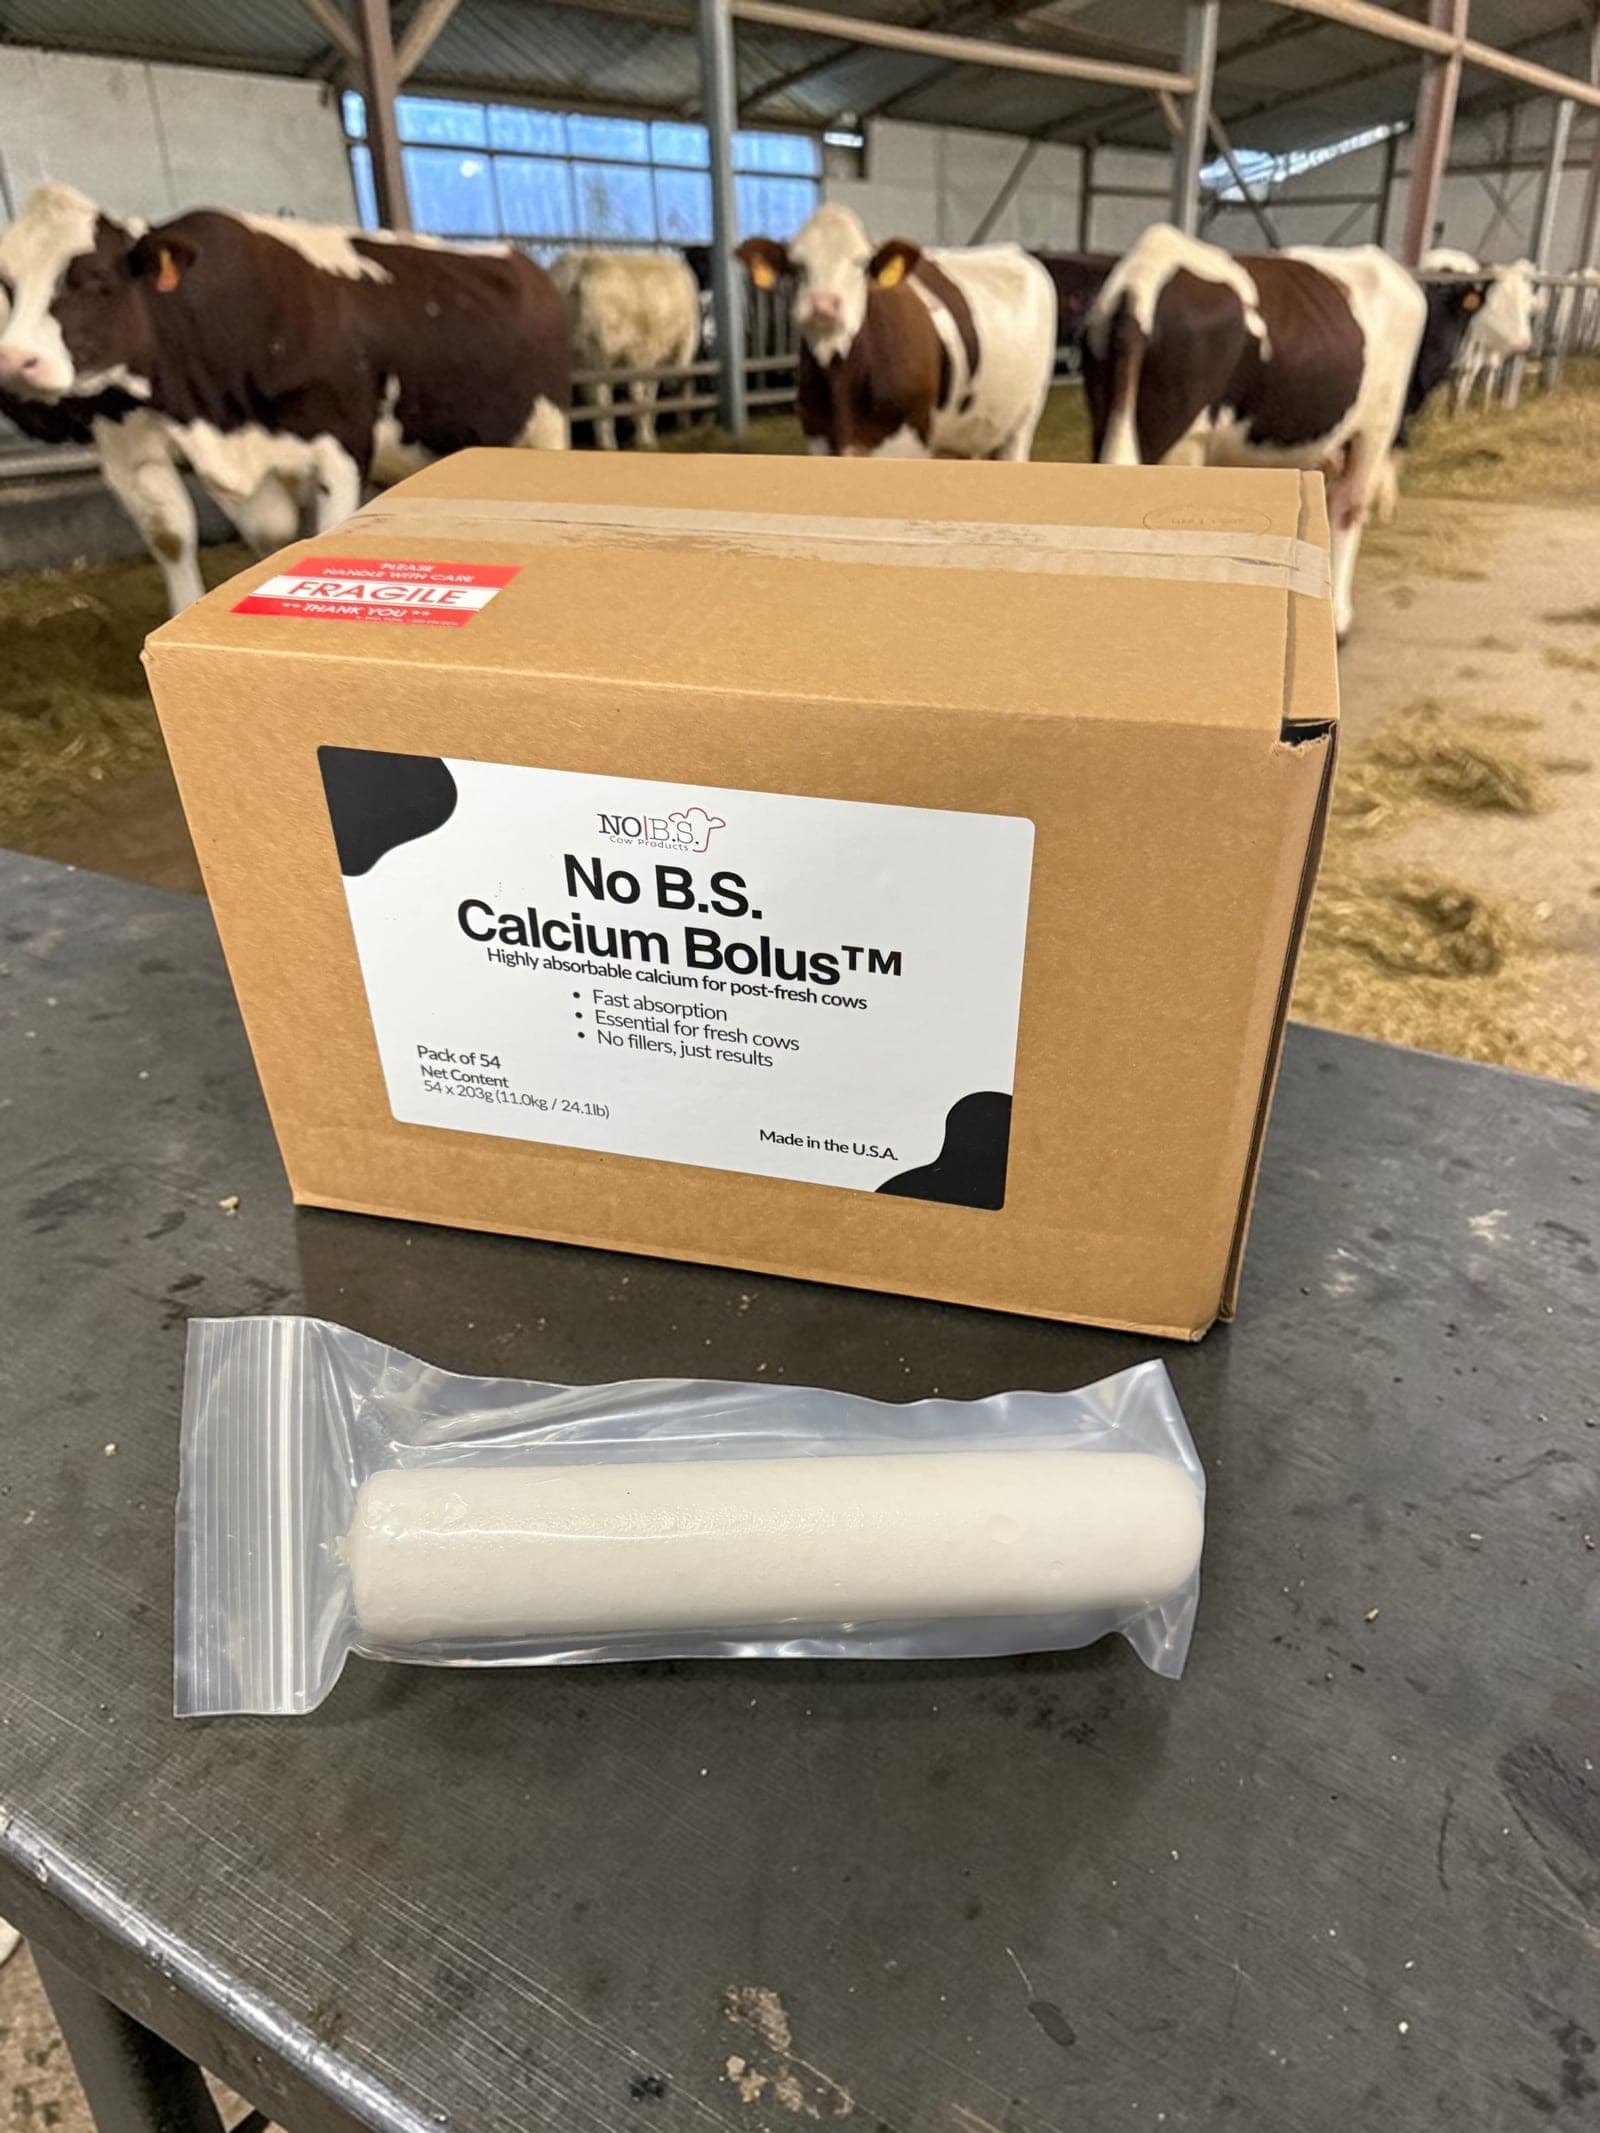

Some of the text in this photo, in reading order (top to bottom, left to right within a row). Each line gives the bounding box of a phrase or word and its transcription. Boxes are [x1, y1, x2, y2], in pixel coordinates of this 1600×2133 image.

[380, 563, 435, 572] PLEASE
[389, 572, 428, 581] WITH
[431, 573, 475, 583] CARE
[288, 581, 466, 604] FRAGILE
[304, 603, 408, 618] THANK YOU
[609, 835, 690, 852] Cow Products
[563, 854, 763, 921] No B.S.
[458, 898, 670, 965] Calcium
[488, 947, 868, 1010] Highly absorbable calcium for post-fresh cows
[593, 989, 728, 1022] Fast absorption
[595, 1009, 800, 1052] Essential for fresh cows
[417, 1045, 501, 1069] Pack of 54
[598, 1030, 774, 1068] No fillers, just results
[421, 1065, 510, 1089] Net Content
[424, 1080, 610, 1119] 54 x 203g (11.0kg / 24.1lb)
[760, 1129, 899, 1161] Made in the U.S.A.
